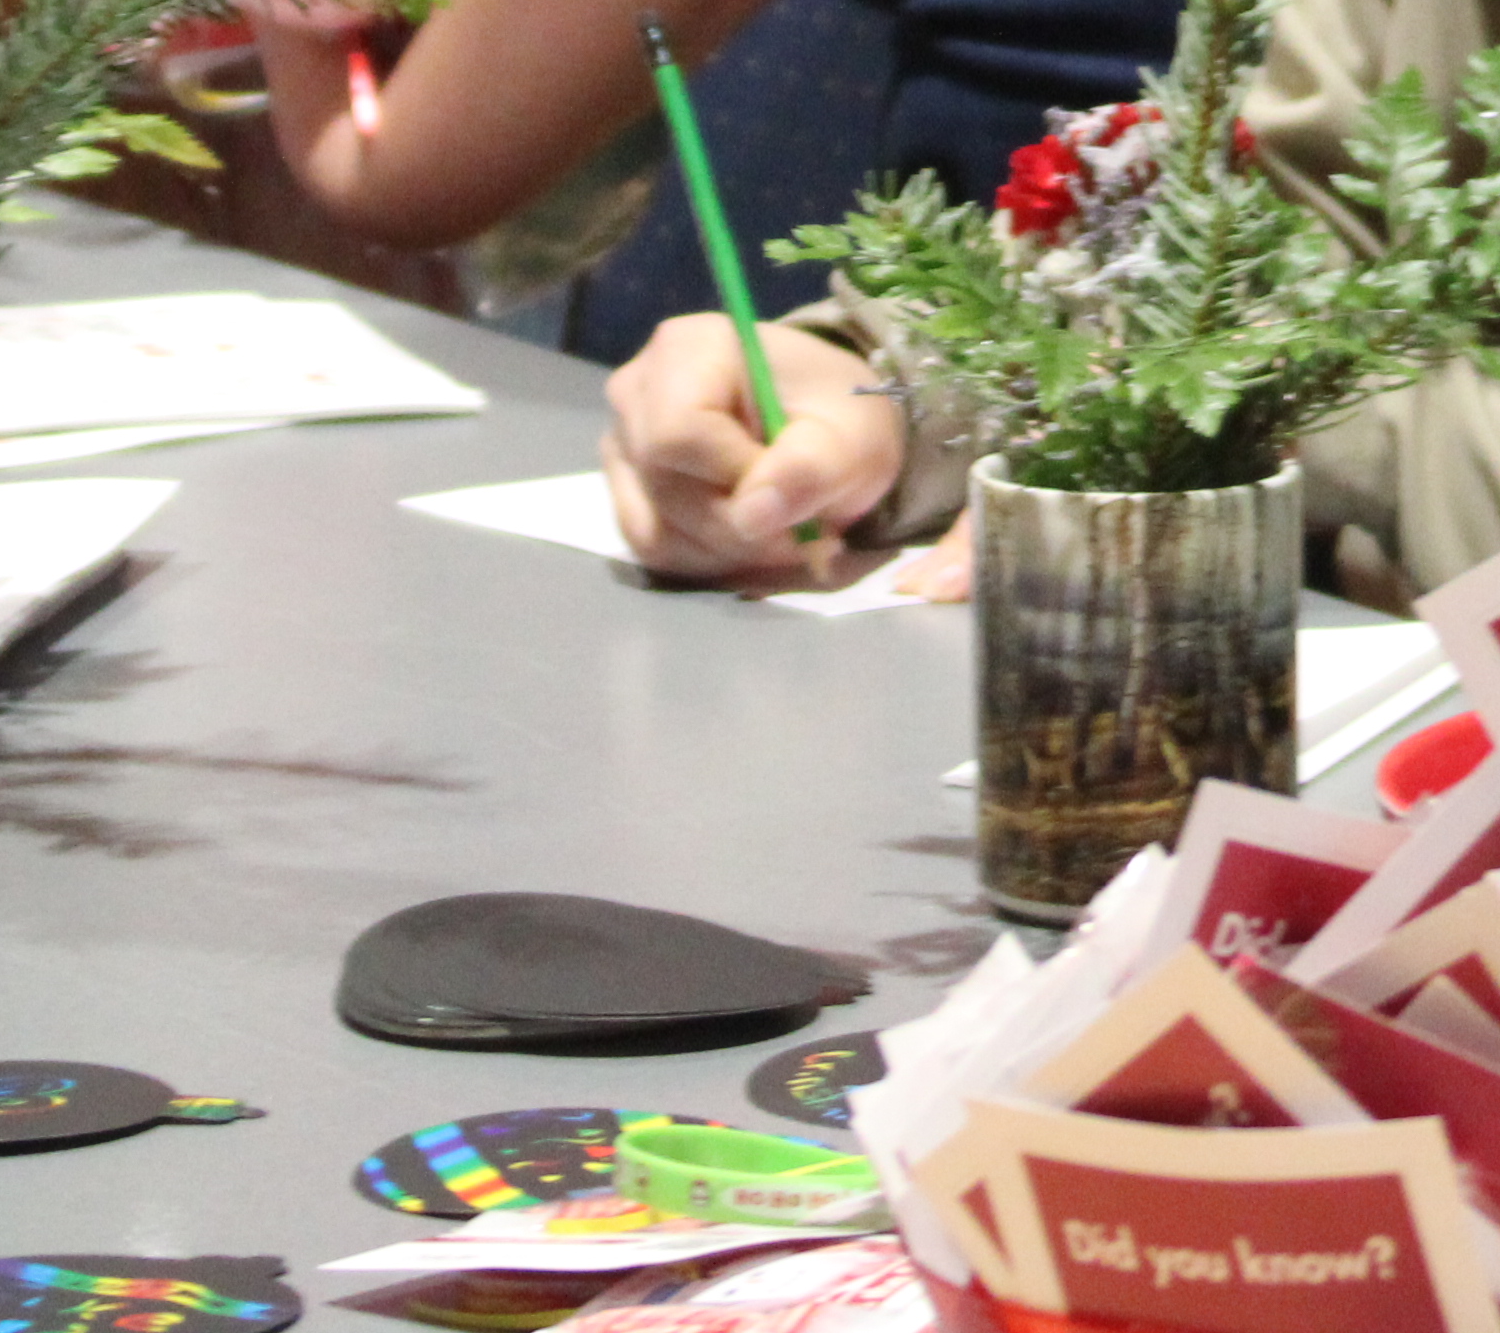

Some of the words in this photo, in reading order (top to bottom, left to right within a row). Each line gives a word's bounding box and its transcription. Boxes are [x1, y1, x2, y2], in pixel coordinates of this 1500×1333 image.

[1062, 1219, 1139, 1273] Did
[1144, 1244, 1230, 1289] you
[1231, 1234, 1397, 1284] know?
